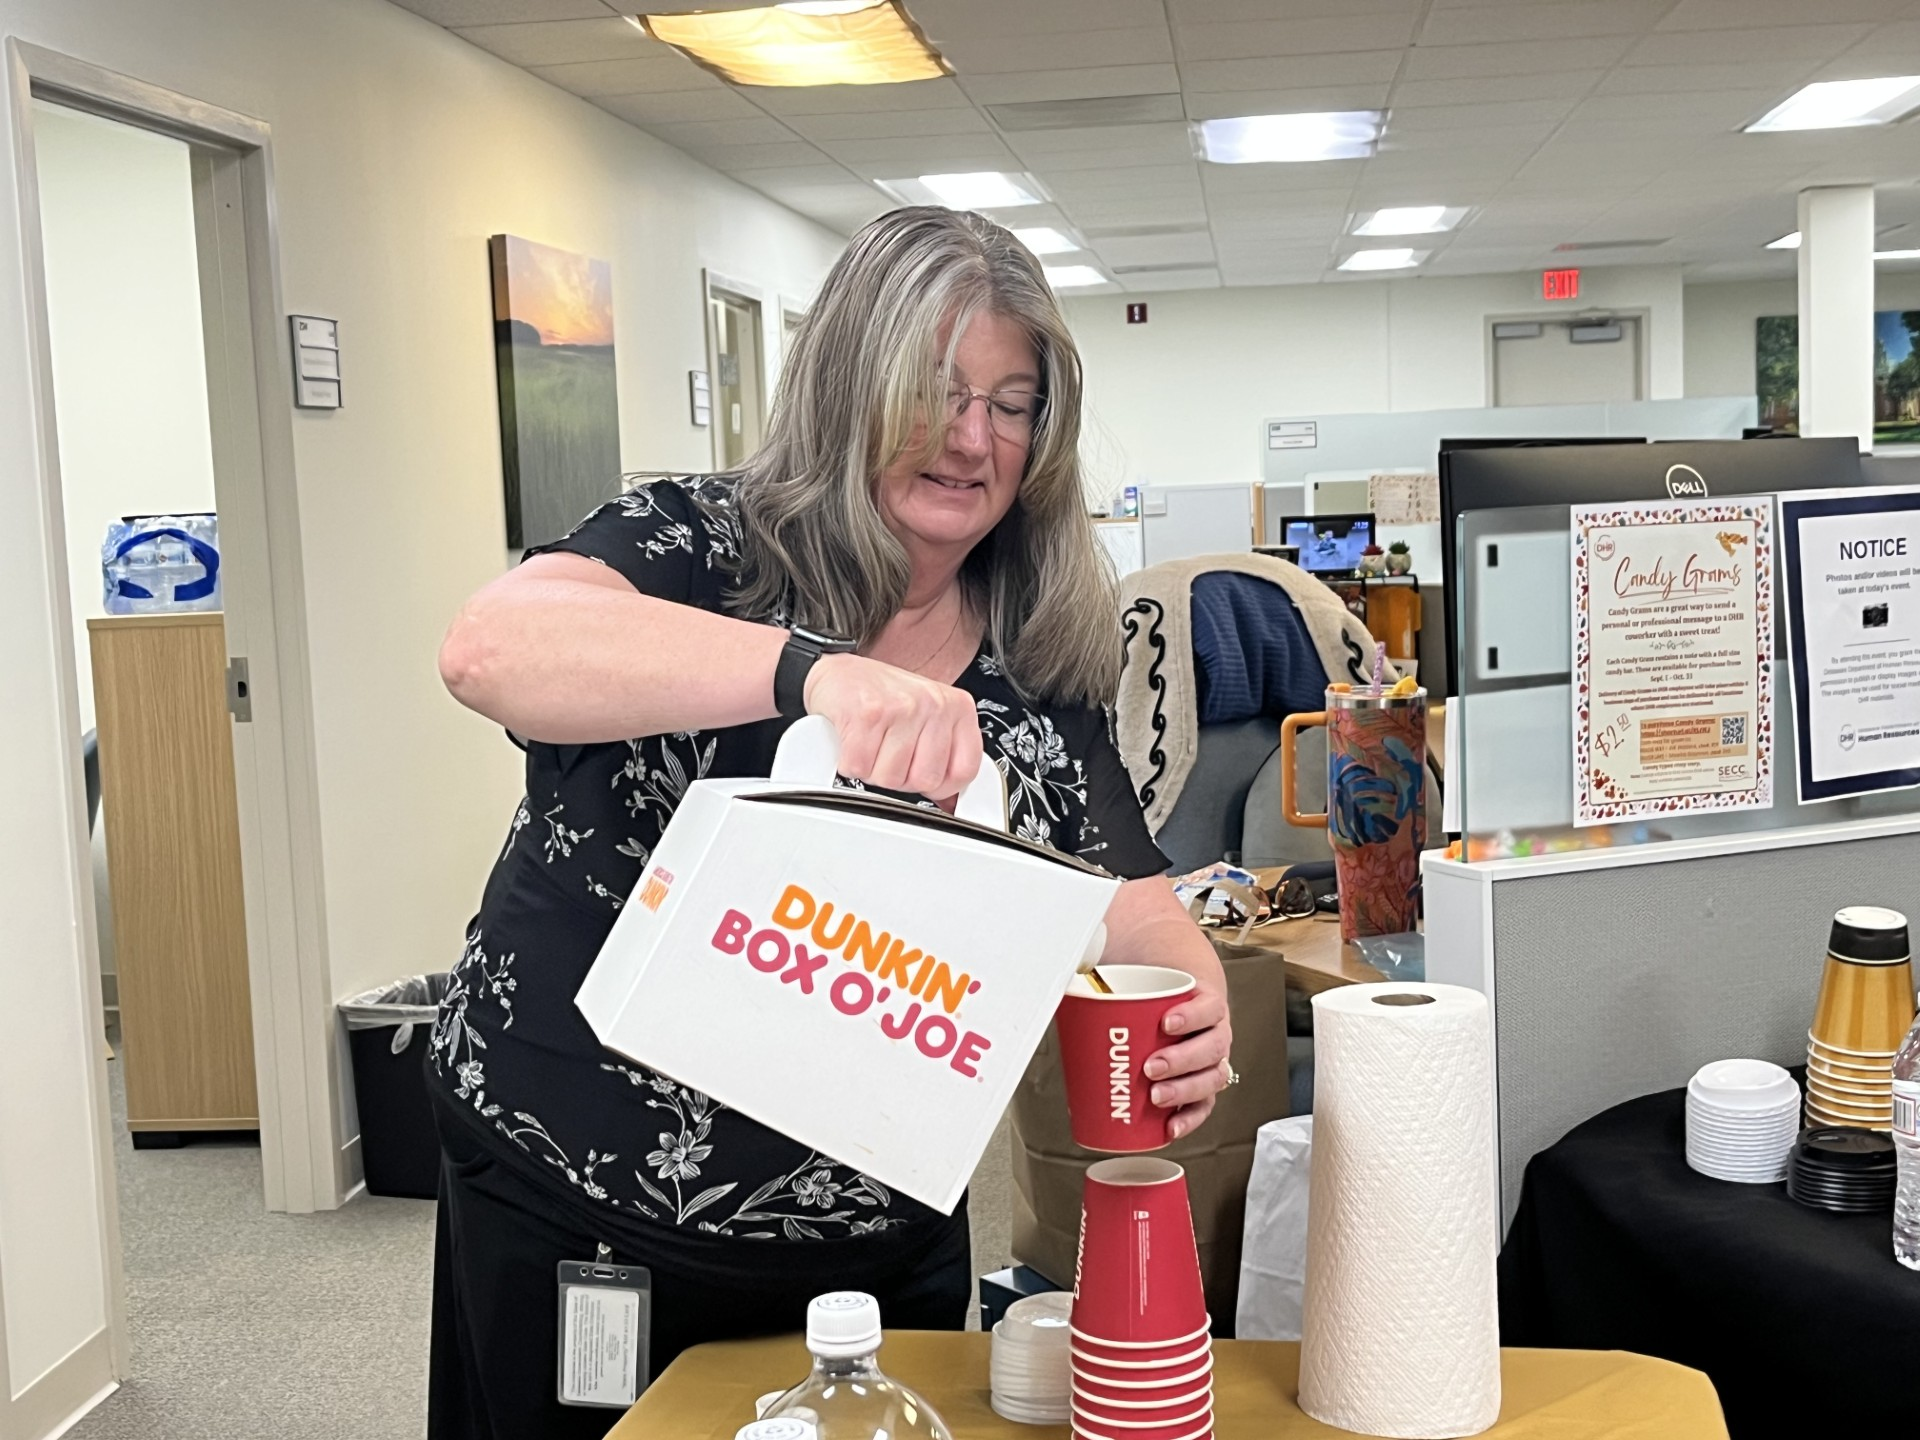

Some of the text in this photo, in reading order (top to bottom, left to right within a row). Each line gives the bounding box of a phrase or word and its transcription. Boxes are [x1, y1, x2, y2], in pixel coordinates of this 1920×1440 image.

[1543, 270, 1579, 300] EXIT
[1672, 481, 1703, 494] DELL
[1840, 537, 1907, 560] NOTICE
[1614, 553, 1742, 600] Candy Grams
[1826, 574, 1852, 582] Photos
[1838, 587, 1856, 595] taken
[1866, 584, 1889, 592] today's
[1608, 608, 1629, 616] Candy
[1630, 606, 1652, 615] Grams
[1670, 604, 1689, 614] great
[1690, 604, 1704, 613] way
[1601, 620, 1630, 631] personal
[1641, 616, 1682, 628] professional
[1714, 614, 1722, 622] to
[1657, 630, 1673, 638] with
[1718, 764, 1745, 776] SECC
[710, 907, 829, 996] BOX
[771, 883, 983, 1015] DUNKIN'
[1107, 1025, 1131, 1126] DUNKIN'
